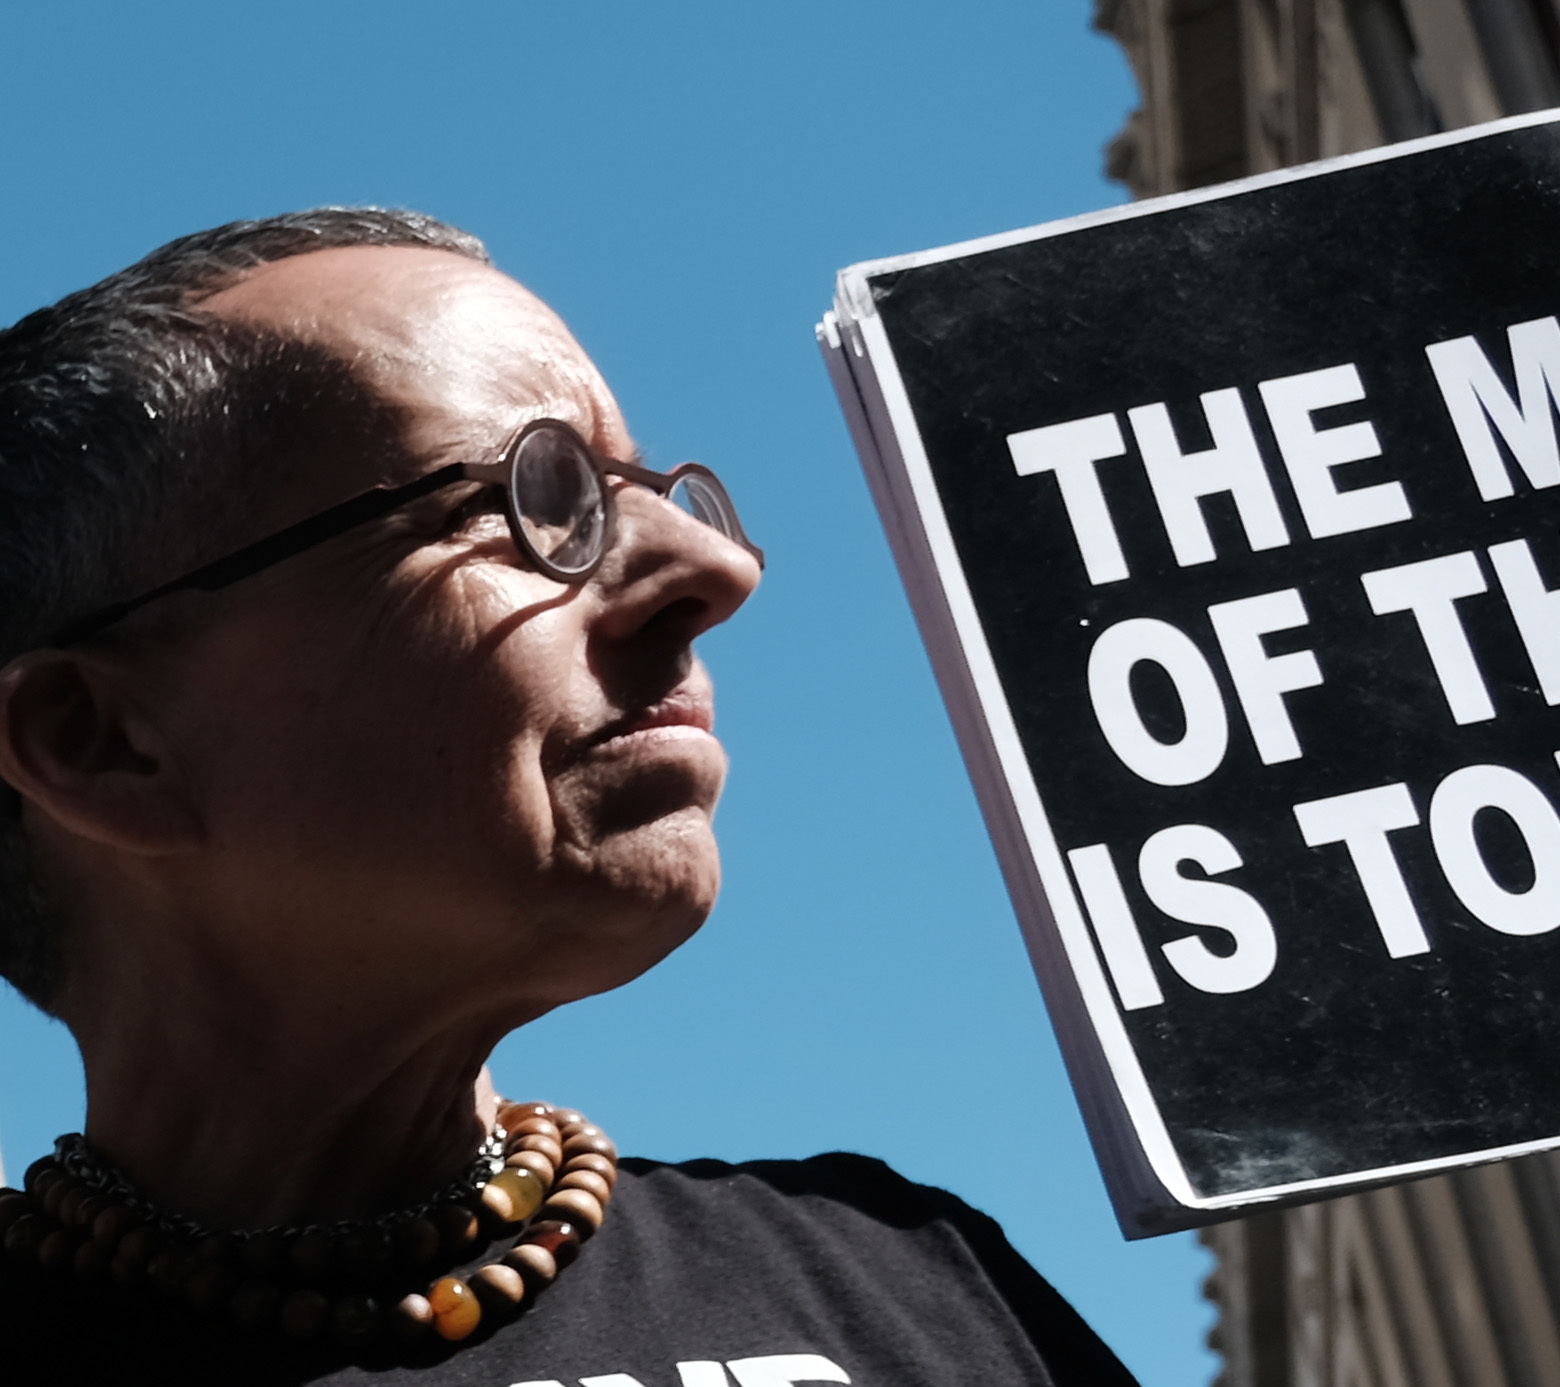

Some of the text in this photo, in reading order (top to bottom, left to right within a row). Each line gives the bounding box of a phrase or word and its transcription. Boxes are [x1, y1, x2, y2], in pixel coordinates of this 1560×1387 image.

[1007, 315, 1560, 586] THE M
[1088, 588, 1323, 786] OF
[1068, 750, 1560, 1011] IS TO
